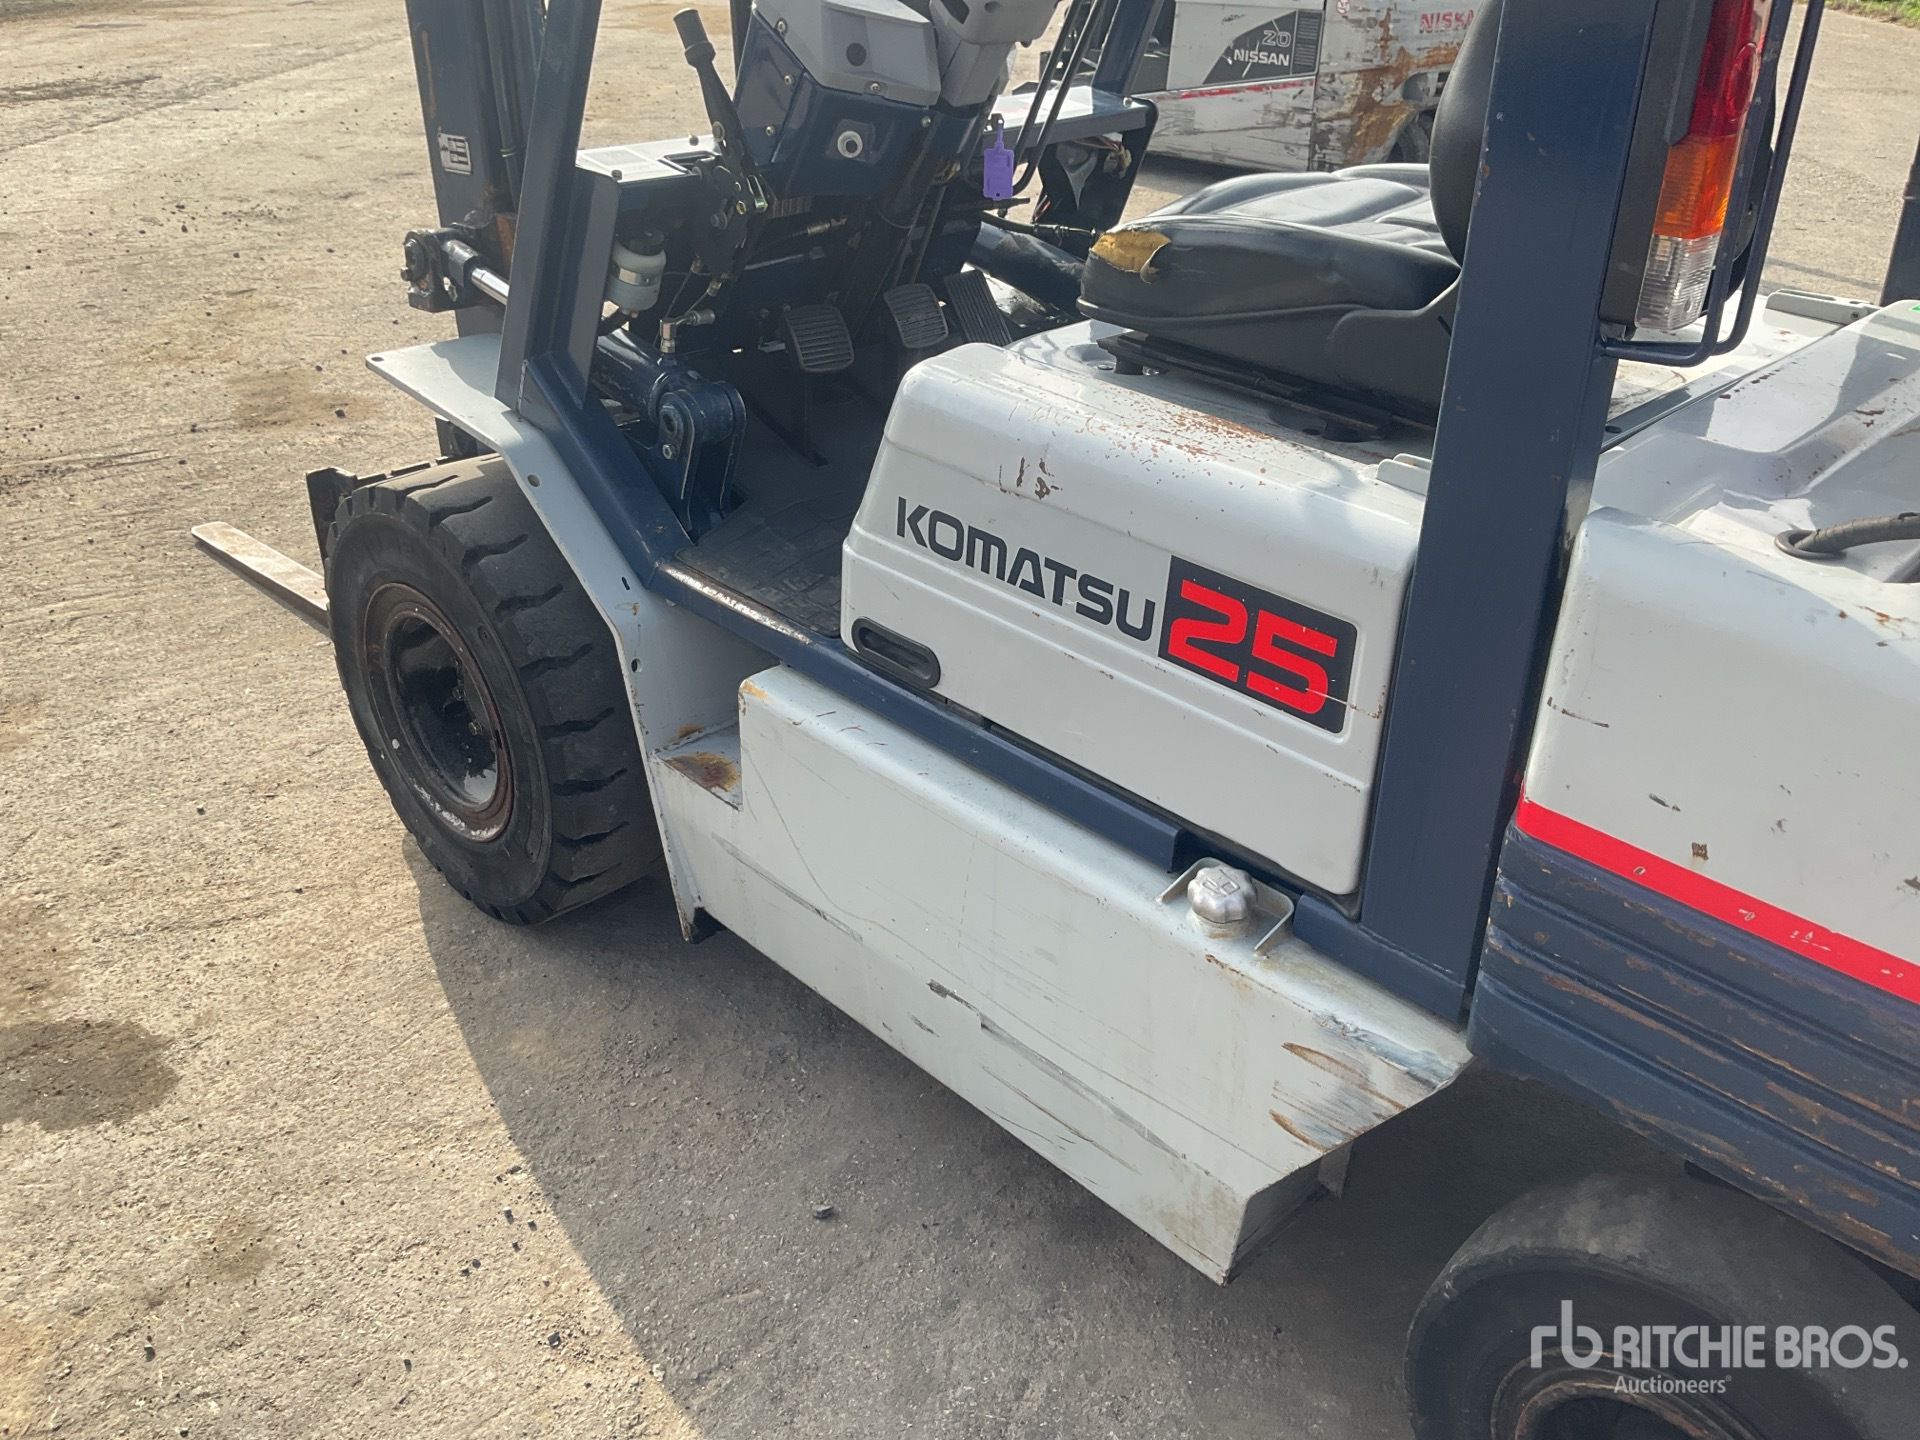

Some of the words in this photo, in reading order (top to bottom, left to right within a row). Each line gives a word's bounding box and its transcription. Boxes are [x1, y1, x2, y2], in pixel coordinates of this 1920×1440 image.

[1262, 29, 1291, 47] 20
[1233, 49, 1289, 66] NISSAN
[897, 496, 1156, 642] KOMATSU
[1167, 579, 1338, 714] 25
